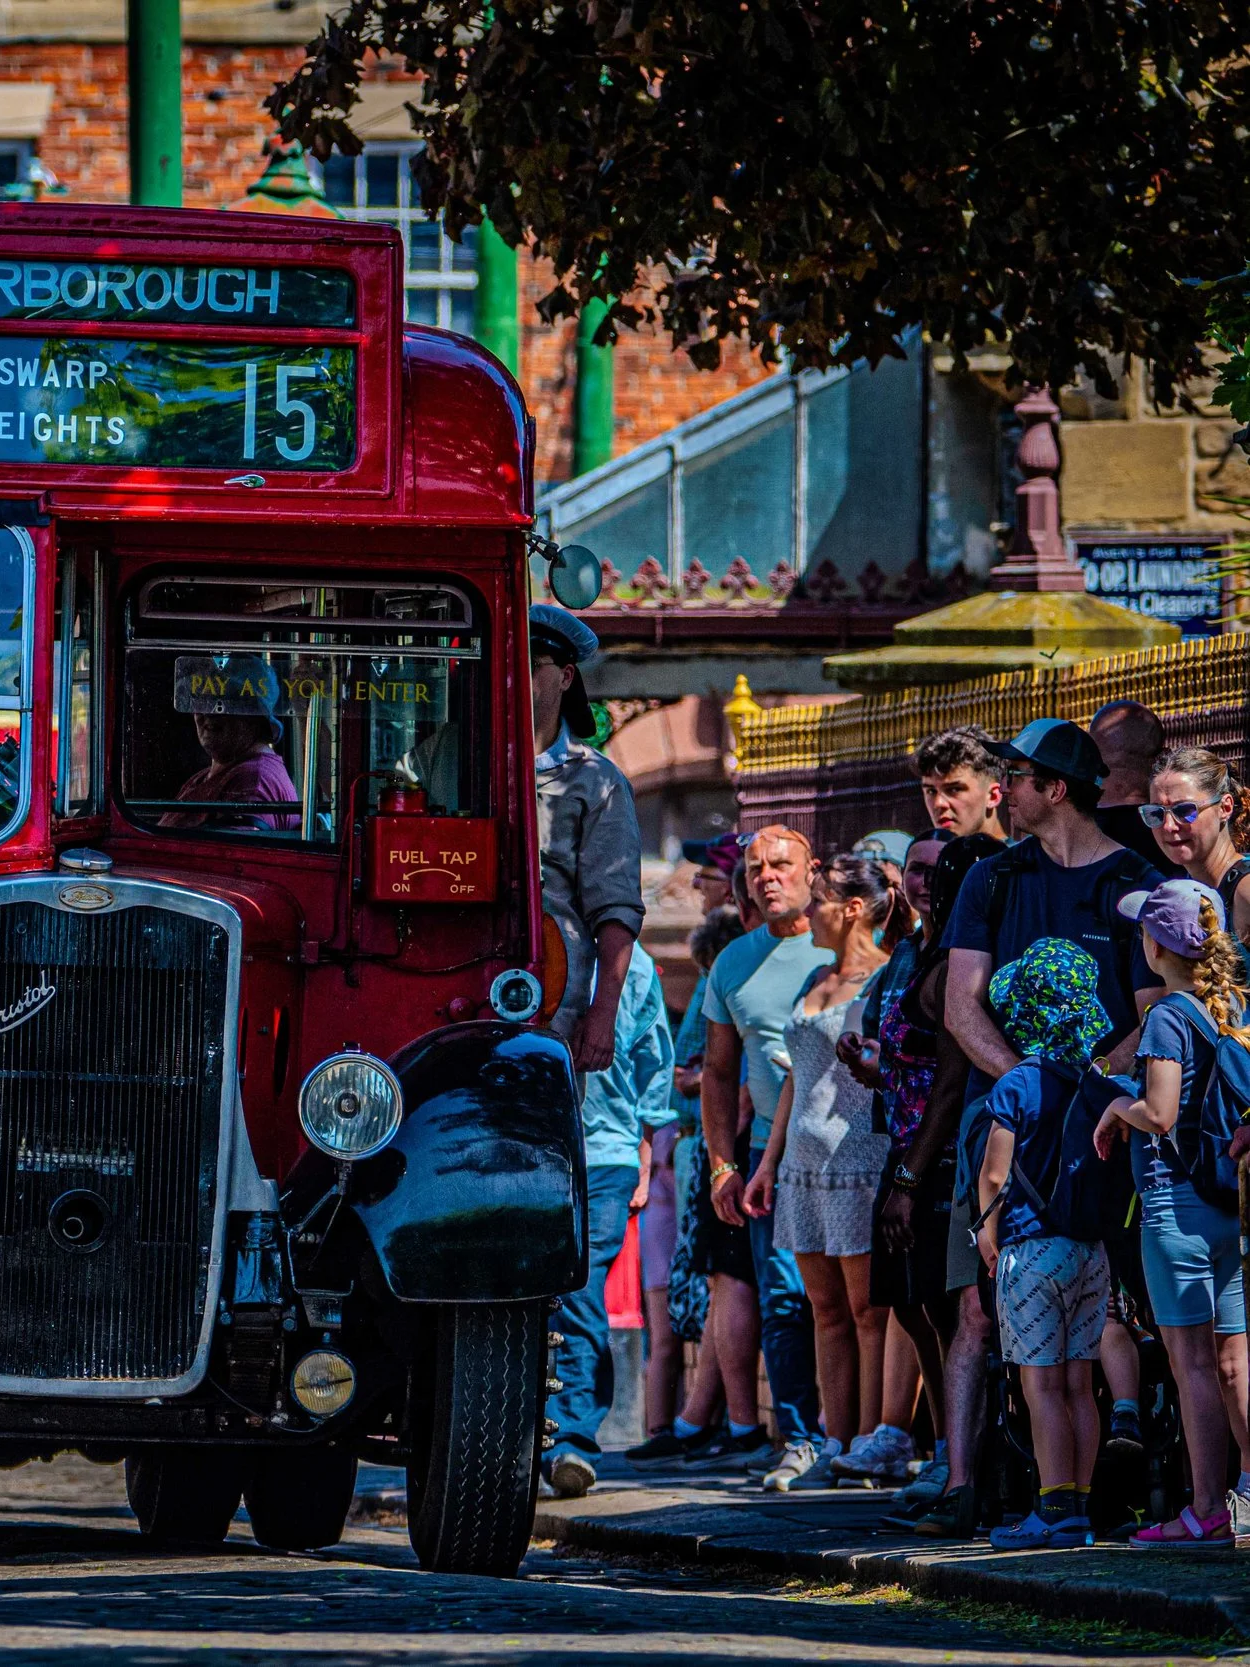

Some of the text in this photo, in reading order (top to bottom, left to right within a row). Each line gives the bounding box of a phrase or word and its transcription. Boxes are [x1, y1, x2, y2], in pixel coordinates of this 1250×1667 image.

[243, 361, 317, 463] 15
[191, 674, 432, 704] PAY AS YOU ENTER
[389, 850, 478, 865] FUEL TAP
[391, 882, 476, 894] ON OFF
